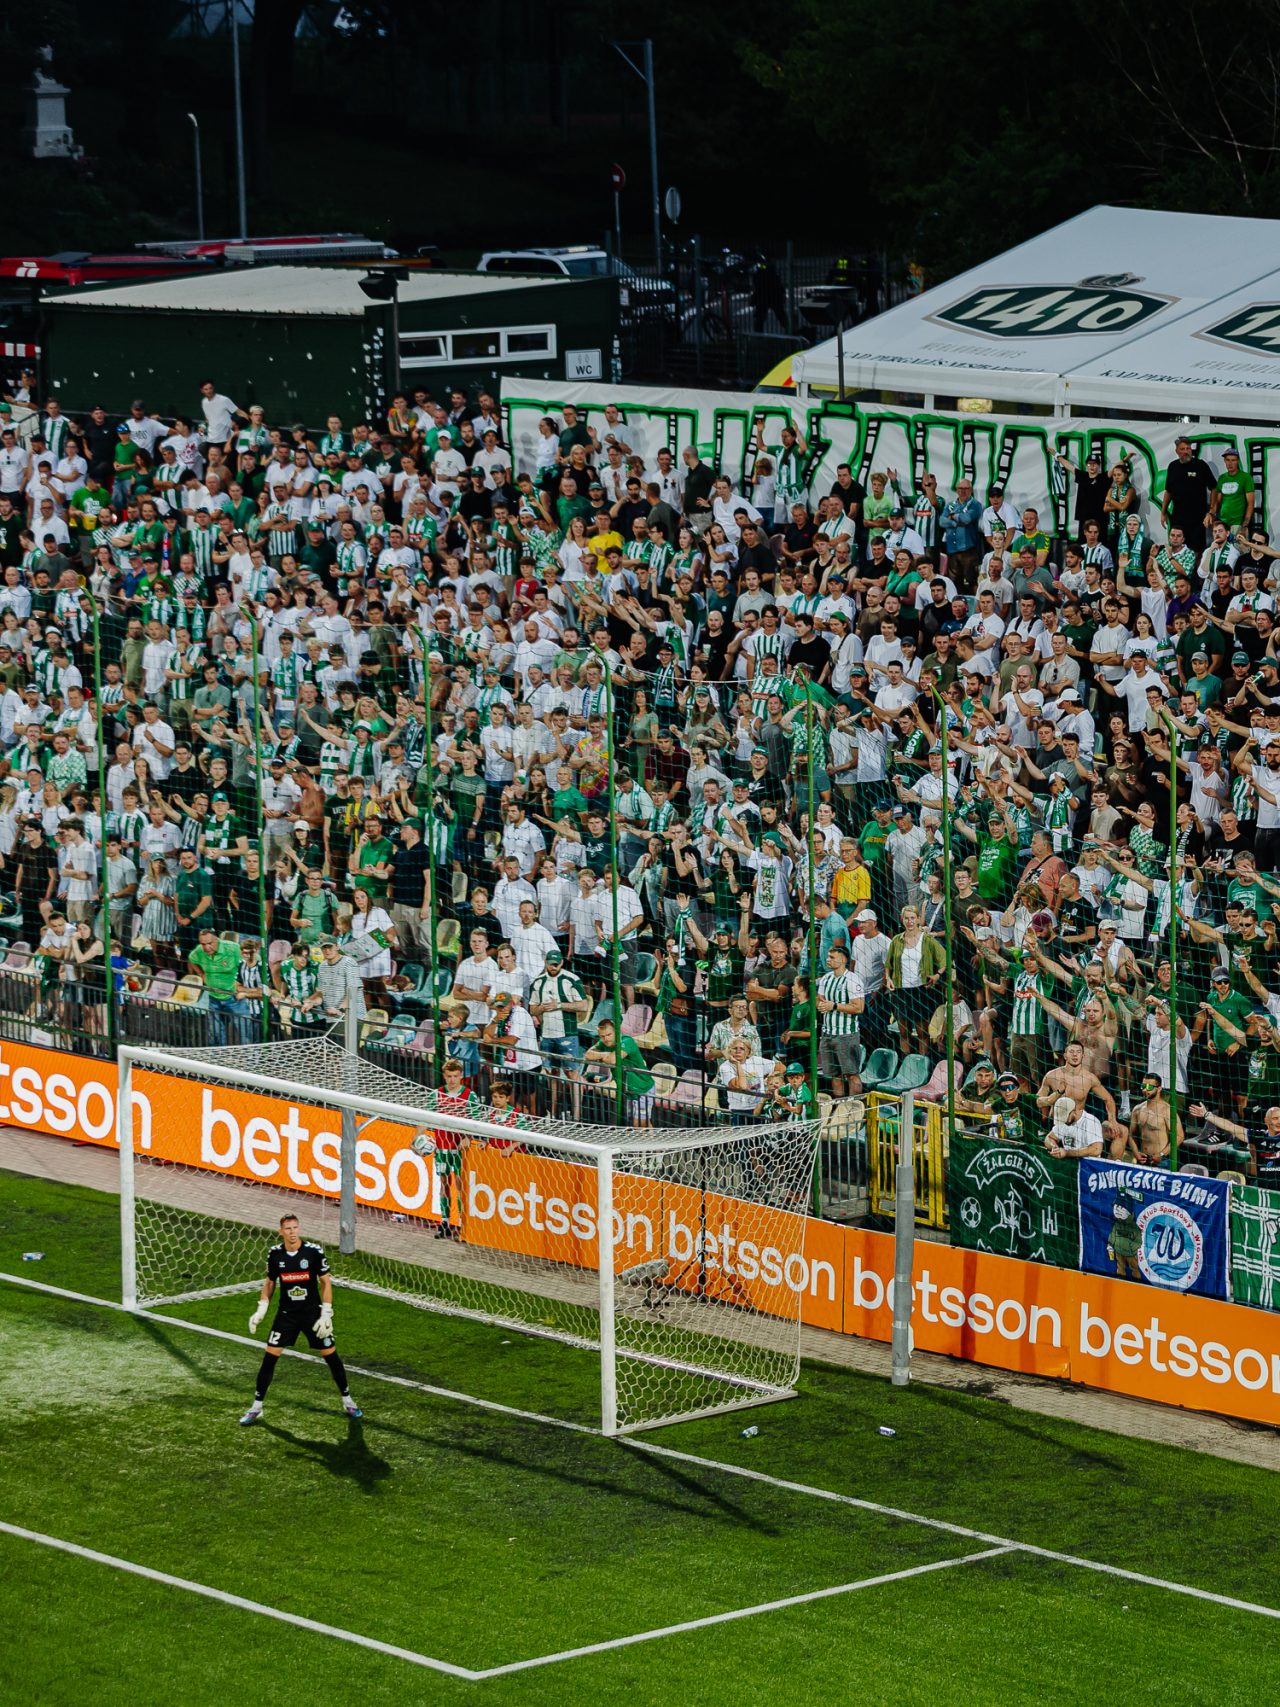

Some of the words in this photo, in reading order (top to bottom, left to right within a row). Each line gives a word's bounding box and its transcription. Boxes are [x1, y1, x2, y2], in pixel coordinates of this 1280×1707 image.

[954, 289, 1144, 332] 1410
[575, 365, 593, 375] WC
[1100, 368, 1138, 379] KAD
[982, 1153, 1036, 1180] ŽALGIRIS
[1087, 1169, 1167, 1193] SUWALSKIE
[1169, 1179, 1219, 1209] BUMY
[669, 1210, 836, 1301] betsson
[268, 1331, 281, 1345] 12
